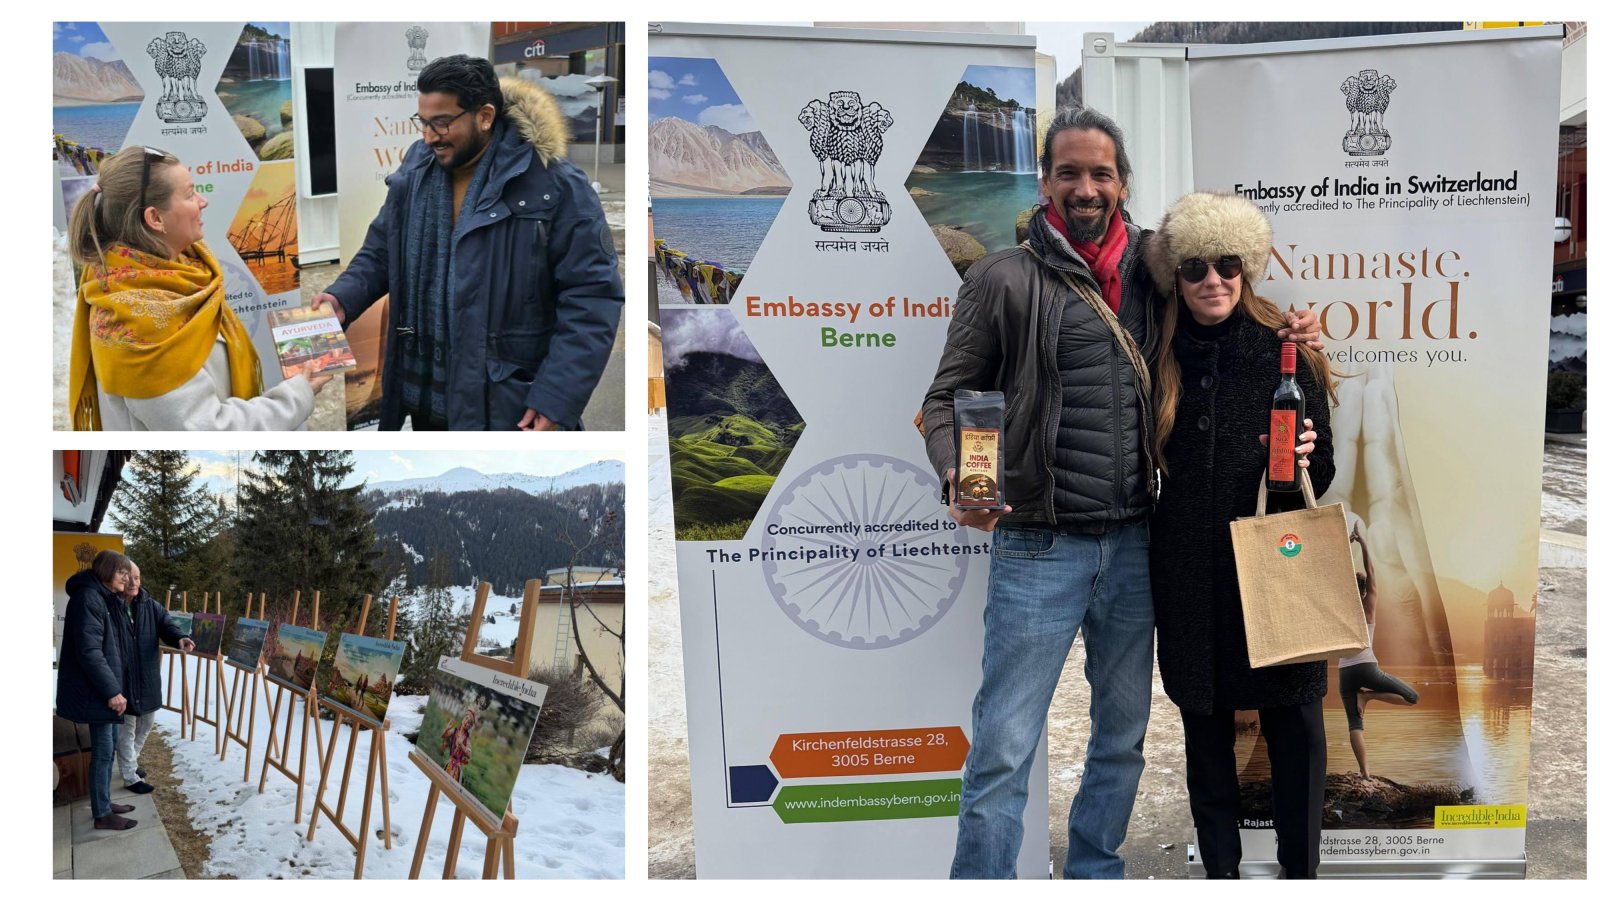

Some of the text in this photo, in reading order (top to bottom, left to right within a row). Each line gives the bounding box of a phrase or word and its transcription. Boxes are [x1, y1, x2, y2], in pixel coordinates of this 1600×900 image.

[524, 43, 545, 58] citi
[355, 82, 391, 95] Embassy
[393, 81, 402, 92] of
[196, 161, 213, 175] of
[217, 159, 254, 174] India
[1234, 169, 1518, 204] Embassy of India in Switzerland
[1283, 199, 1339, 212] accredited
[1342, 200, 1353, 210] to
[1356, 198, 1376, 210] The
[1379, 197, 1440, 211] Principality
[1442, 193, 1454, 207] of
[1457, 192, 1531, 207] Liechtenstein)
[815, 236, 890, 253] सत्यमेव जयते
[244, 291, 254, 299] to
[746, 296, 862, 324] Embassy
[868, 296, 896, 318] of
[1288, 281, 1478, 341] orld.
[281, 320, 334, 337] AYURVEDA
[821, 326, 897, 348] Berne
[1426, 349, 1468, 368] you.
[767, 519, 957, 537] Concurrently accredited to
[706, 548, 742, 563] The
[749, 544, 860, 564] Principality
[866, 543, 886, 558] of
[792, 733, 949, 752] Kirchenfeldstrasse 28,
[831, 753, 915, 768] 3005 Berne
[784, 791, 962, 810] www.indembassybern.gov.in
[1365, 835, 1383, 847] 28,
[1386, 835, 1414, 846] 3005
[1416, 835, 1445, 846] Berne
